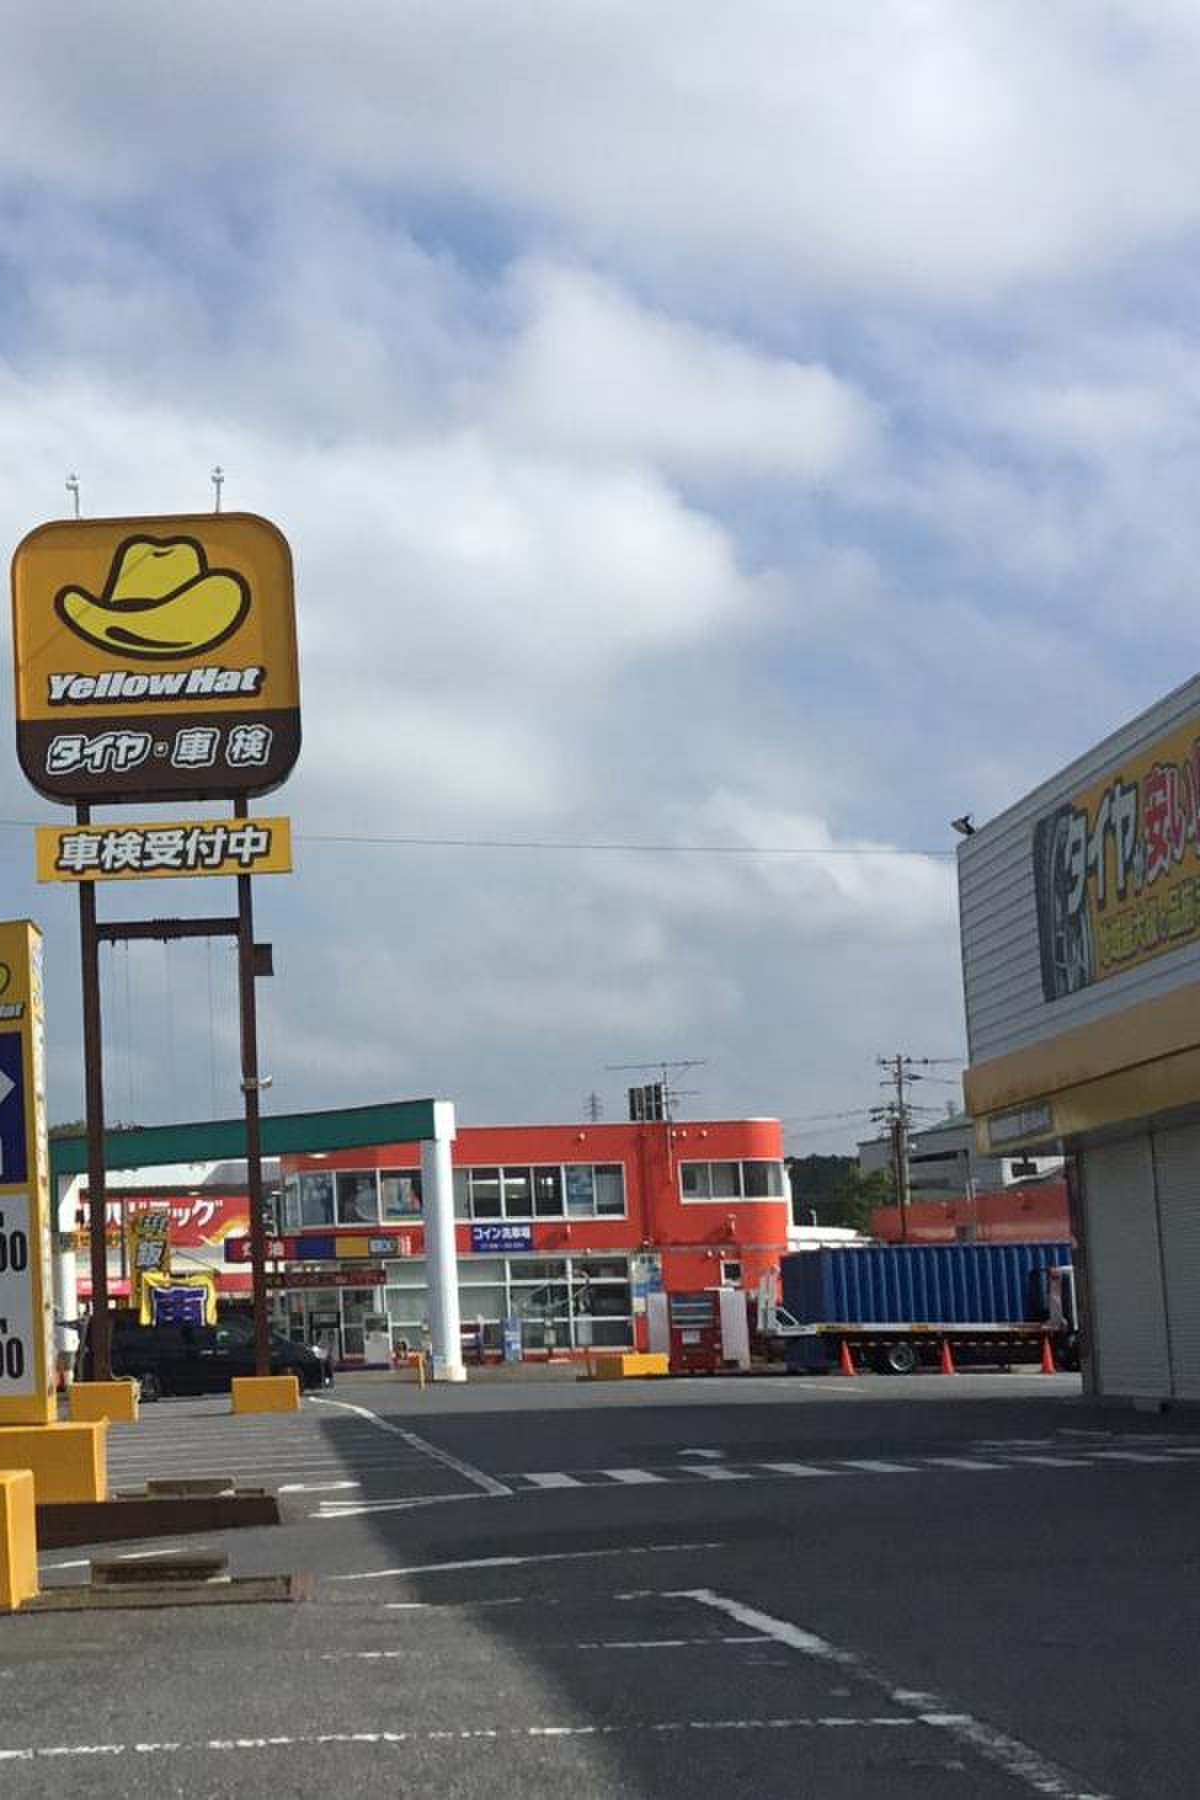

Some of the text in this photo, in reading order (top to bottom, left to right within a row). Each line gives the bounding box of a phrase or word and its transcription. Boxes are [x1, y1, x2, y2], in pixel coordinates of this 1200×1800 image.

[57, 826, 270, 871] 車検受付中
